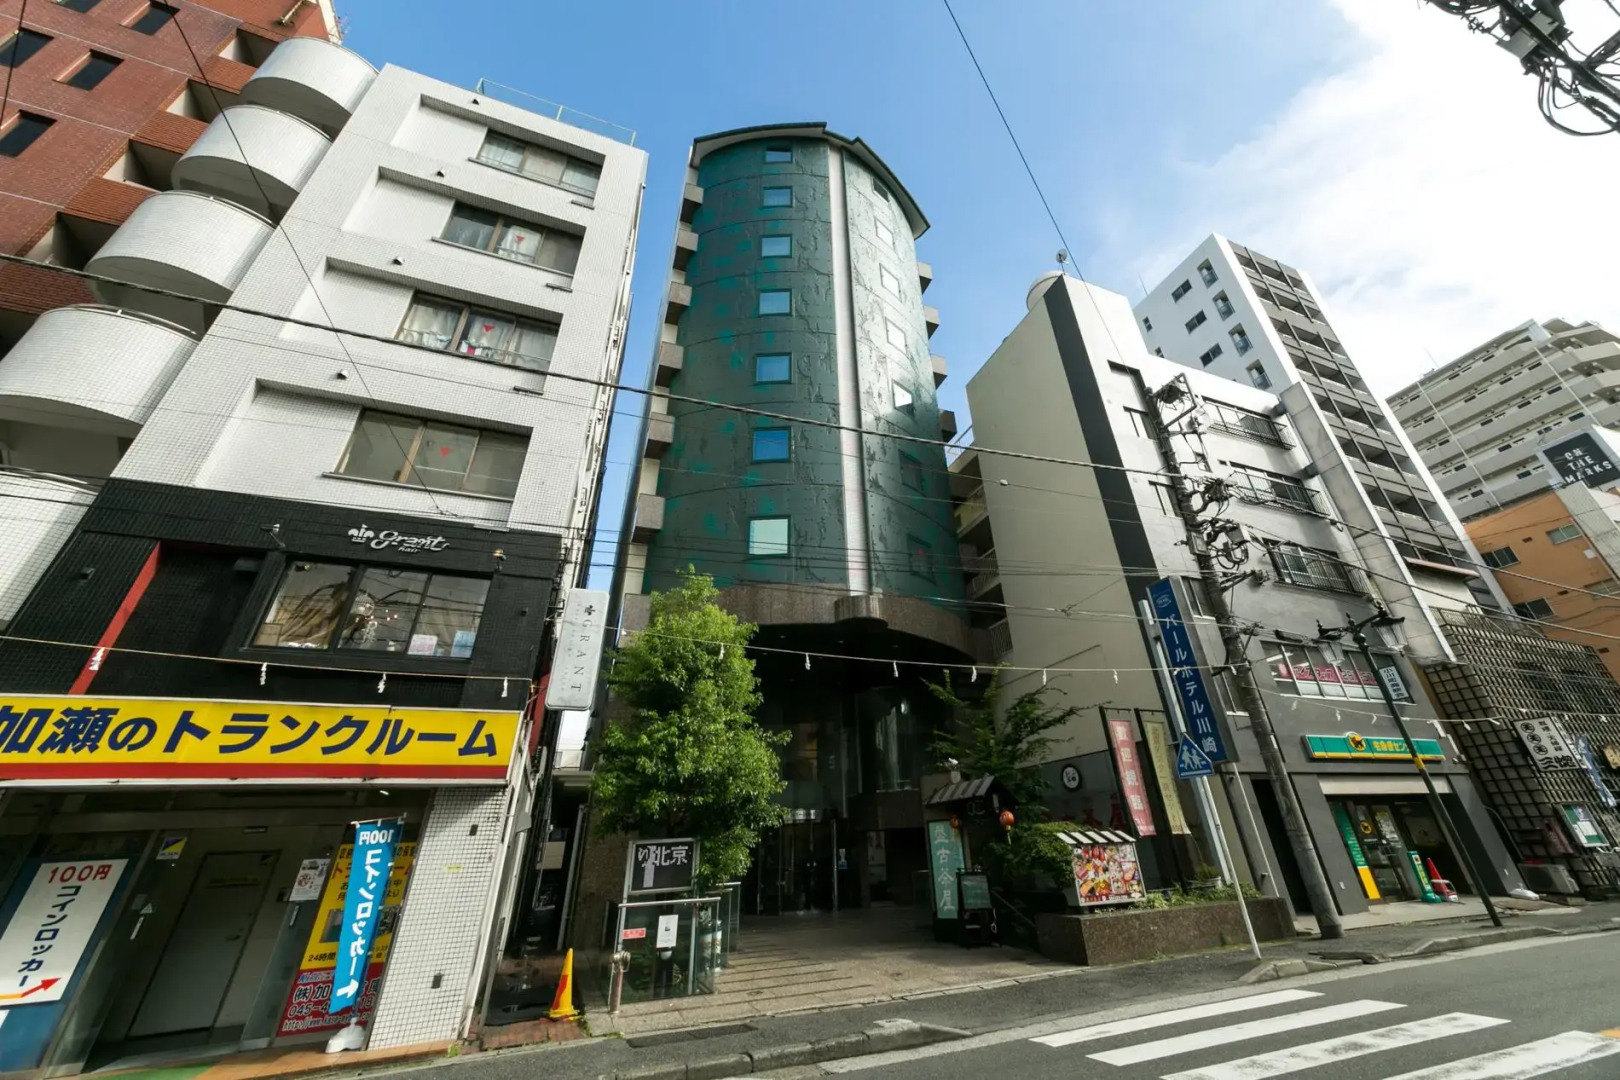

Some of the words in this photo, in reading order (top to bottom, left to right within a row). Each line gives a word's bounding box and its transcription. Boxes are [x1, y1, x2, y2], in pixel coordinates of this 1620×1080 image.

[1564, 447, 1583, 460] ON
[1564, 460, 1613, 484] MARKS
[1567, 455, 1594, 471] THE
[571, 619, 592, 692] GRANT
[1165, 612, 1218, 753] パールホテル川崎
[0, 705, 497, 757] 加瀬のトランクルーム
[48, 864, 112, 884] 100円
[18, 885, 82, 987] コインロッカー
